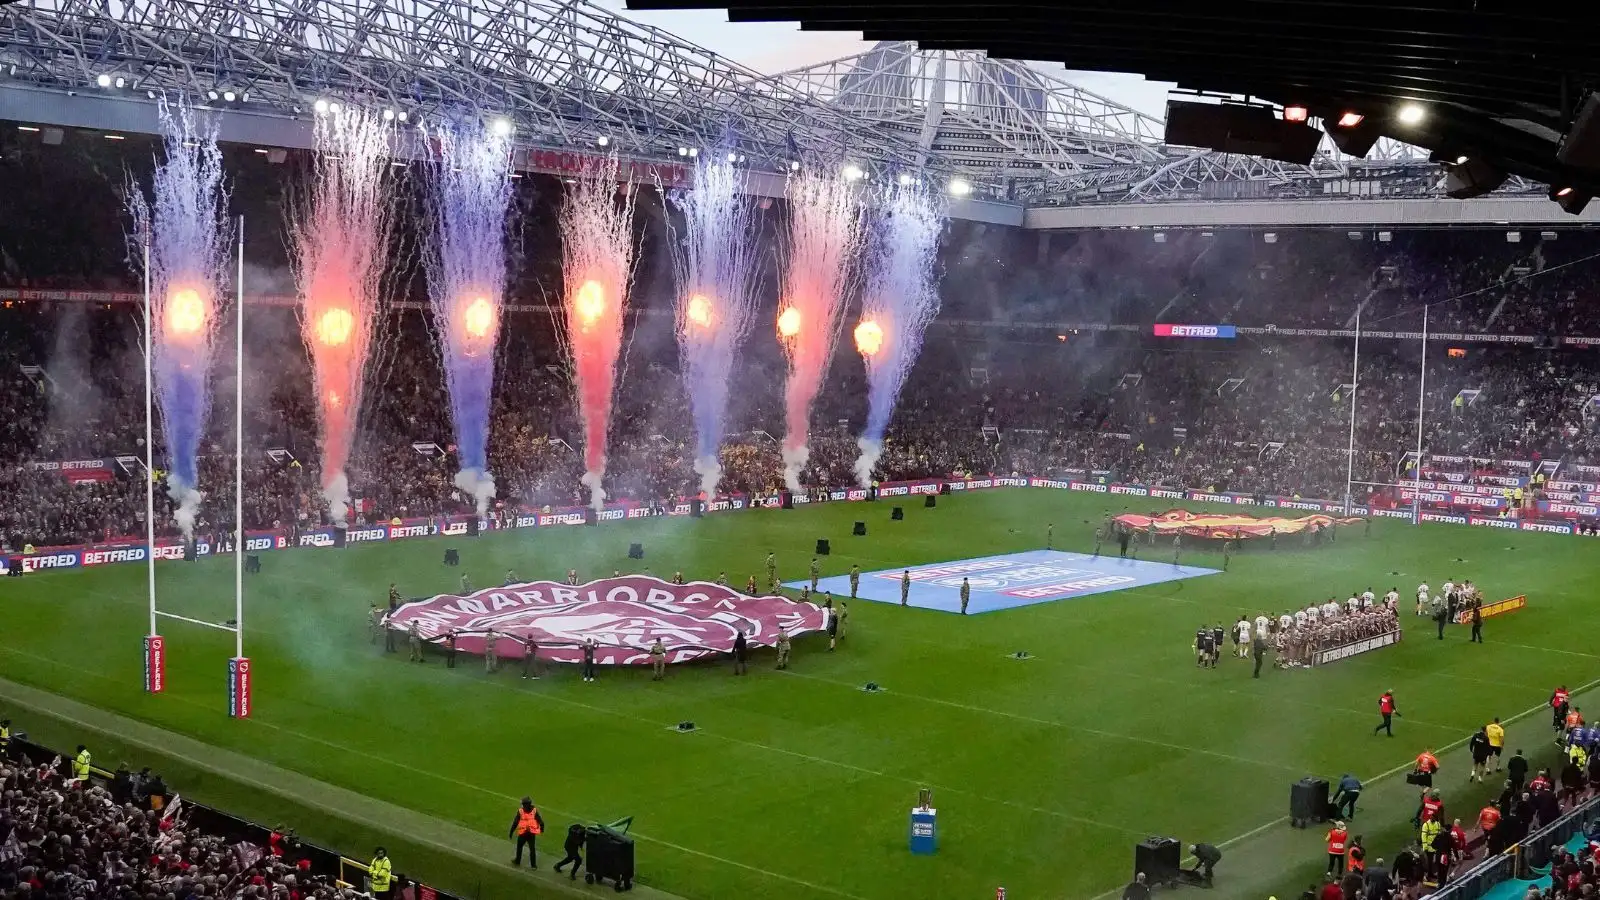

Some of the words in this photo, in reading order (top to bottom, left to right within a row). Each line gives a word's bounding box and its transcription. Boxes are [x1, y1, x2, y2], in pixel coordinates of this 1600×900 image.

[1172, 326, 1218, 336] BETFRED
[62, 460, 104, 470] BETFRED
[1437, 483, 1474, 492] BETFRED
[1402, 492, 1444, 502] BETFRED
[1454, 496, 1498, 506] BETFRED
[1032, 480, 1068, 488] BETFRED
[1072, 482, 1106, 492] BETFRED
[1111, 486, 1147, 496] BETFRED
[1193, 494, 1232, 504] BETFRED
[1280, 502, 1320, 511] BETFRED
[1422, 514, 1466, 524] BETFRED
[1471, 519, 1518, 528] BETFRED
[1522, 523, 1570, 534] BETFRED
[1550, 504, 1598, 514] BETFRED
[22, 554, 76, 569] ETFRED
[84, 548, 145, 564] BETFRED
[880, 486, 908, 496] BETFRED
[968, 480, 992, 488] BETFRED
[1008, 576, 1136, 598] BETFRED
